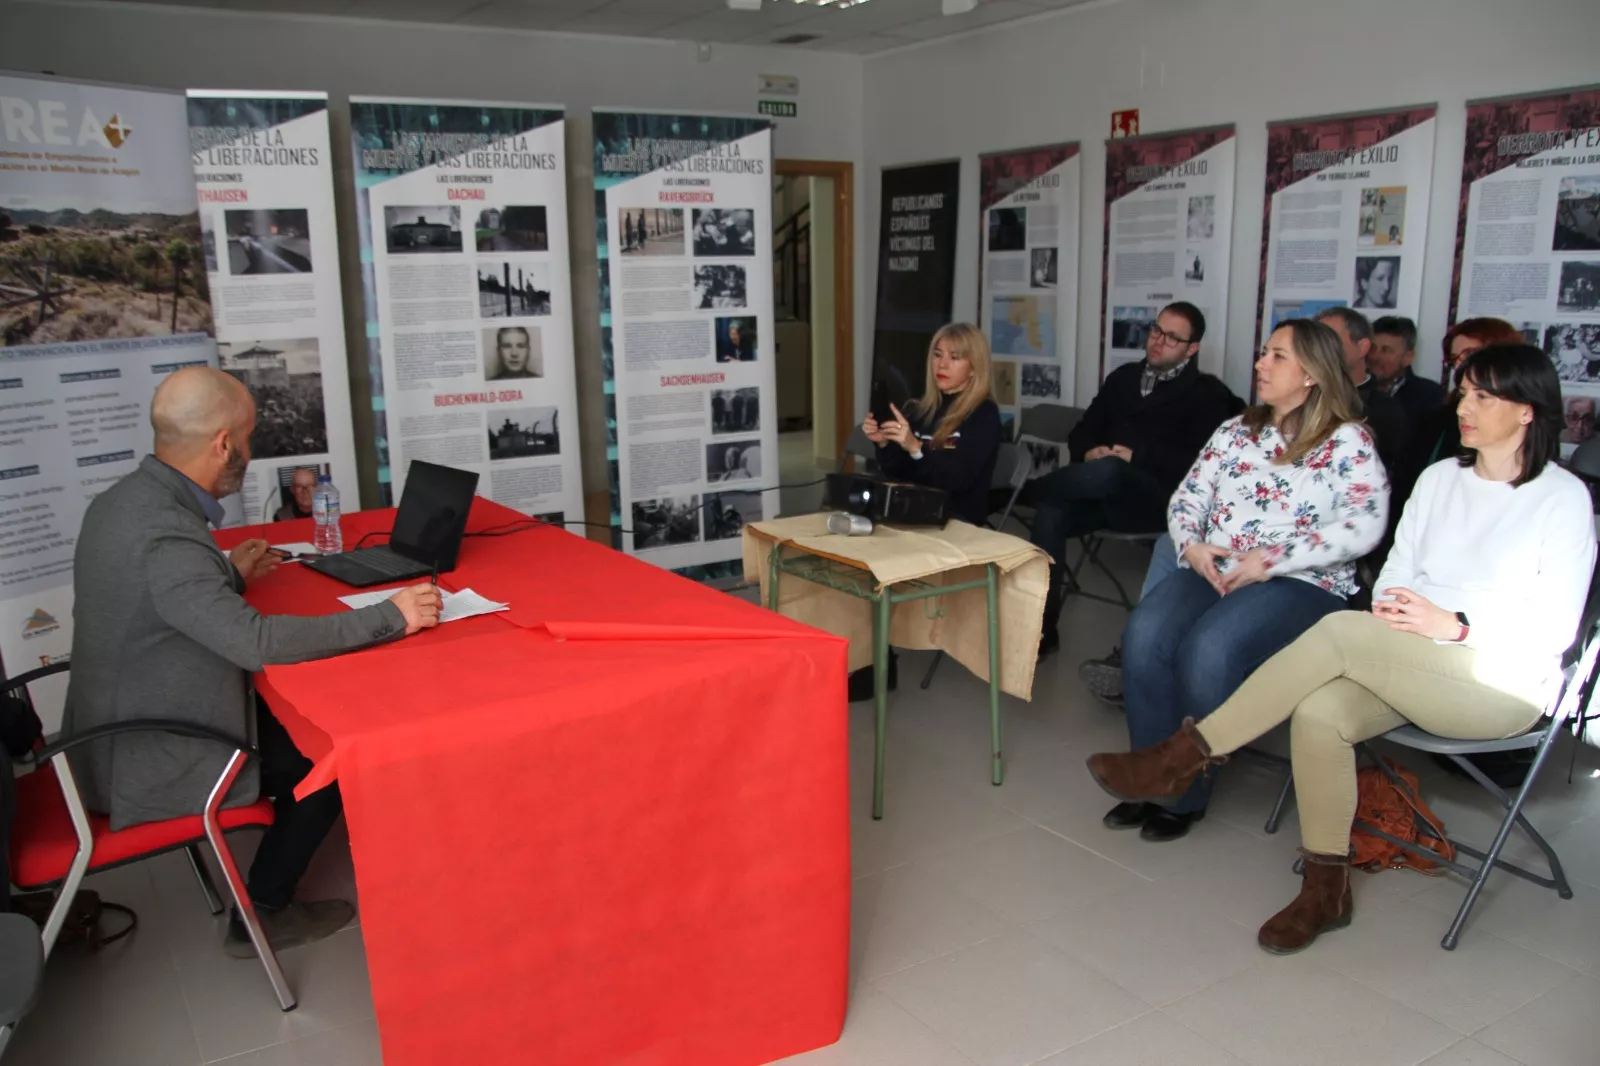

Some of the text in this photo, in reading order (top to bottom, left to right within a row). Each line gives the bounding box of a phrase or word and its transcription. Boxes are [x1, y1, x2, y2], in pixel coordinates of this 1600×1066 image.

[761, 102, 794, 115] SALIDA
[266, 128, 284, 147] LA
[513, 136, 529, 153] LA
[1497, 132, 1566, 156] DERROTA
[1572, 128, 1585, 148] Y
[208, 147, 319, 166] LIBERACIONES
[728, 143, 741, 158] LA
[1348, 149, 1357, 165] Y
[1361, 145, 1398, 165] EXILIO
[436, 151, 462, 169] LAS
[465, 152, 556, 171] LIBERACIONES
[663, 157, 685, 172] LAS
[688, 158, 764, 175] LIBERACIONES
[1178, 160, 1208, 177] EXILIO
[450, 175, 493, 184] LIBERACIONES
[447, 188, 486, 201] DACHAU
[660, 372, 726, 387] SACHSENHAUSEN
[434, 390, 523, 407] BUCHENWALD-DORA
